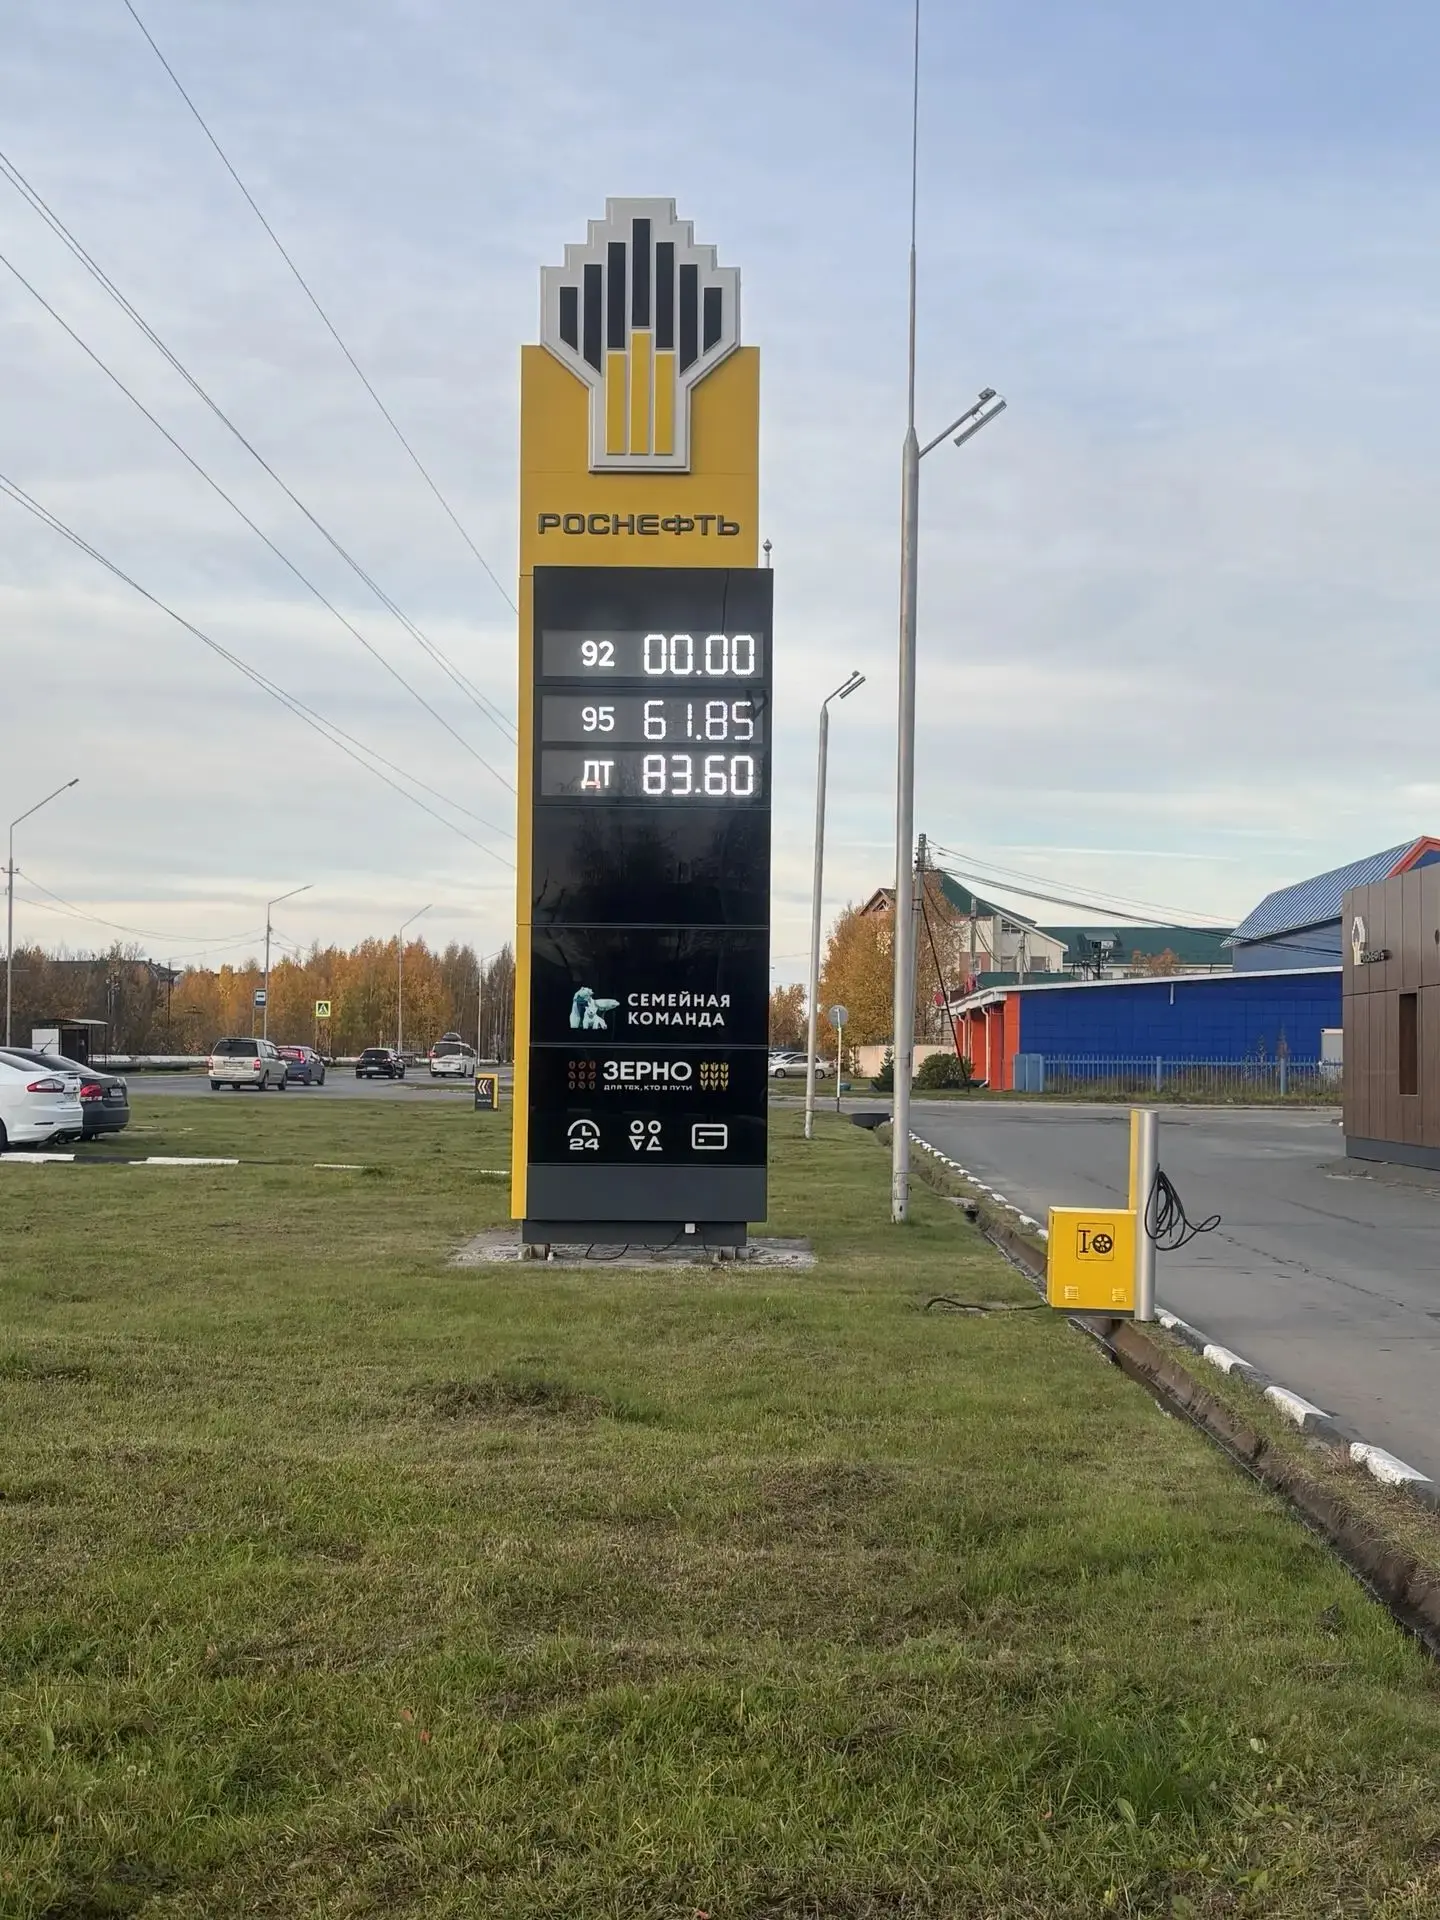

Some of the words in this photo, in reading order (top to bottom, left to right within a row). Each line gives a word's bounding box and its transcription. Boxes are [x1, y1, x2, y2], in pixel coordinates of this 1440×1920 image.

[538, 513, 740, 536] РОСНЕФТЬ
[581, 640, 615, 667] 92
[643, 634, 755, 675] 00.00
[581, 706, 615, 732] 95
[643, 700, 754, 740] 61.85
[581, 760, 615, 789] ДТ
[642, 754, 754, 795] 83.60
[627, 991, 731, 1008] СЕМЕЙНАЯ
[627, 1011, 725, 1027] КОМАНДА
[602, 1061, 692, 1081] ЗЕРНО
[570, 1138, 600, 1150] 24
